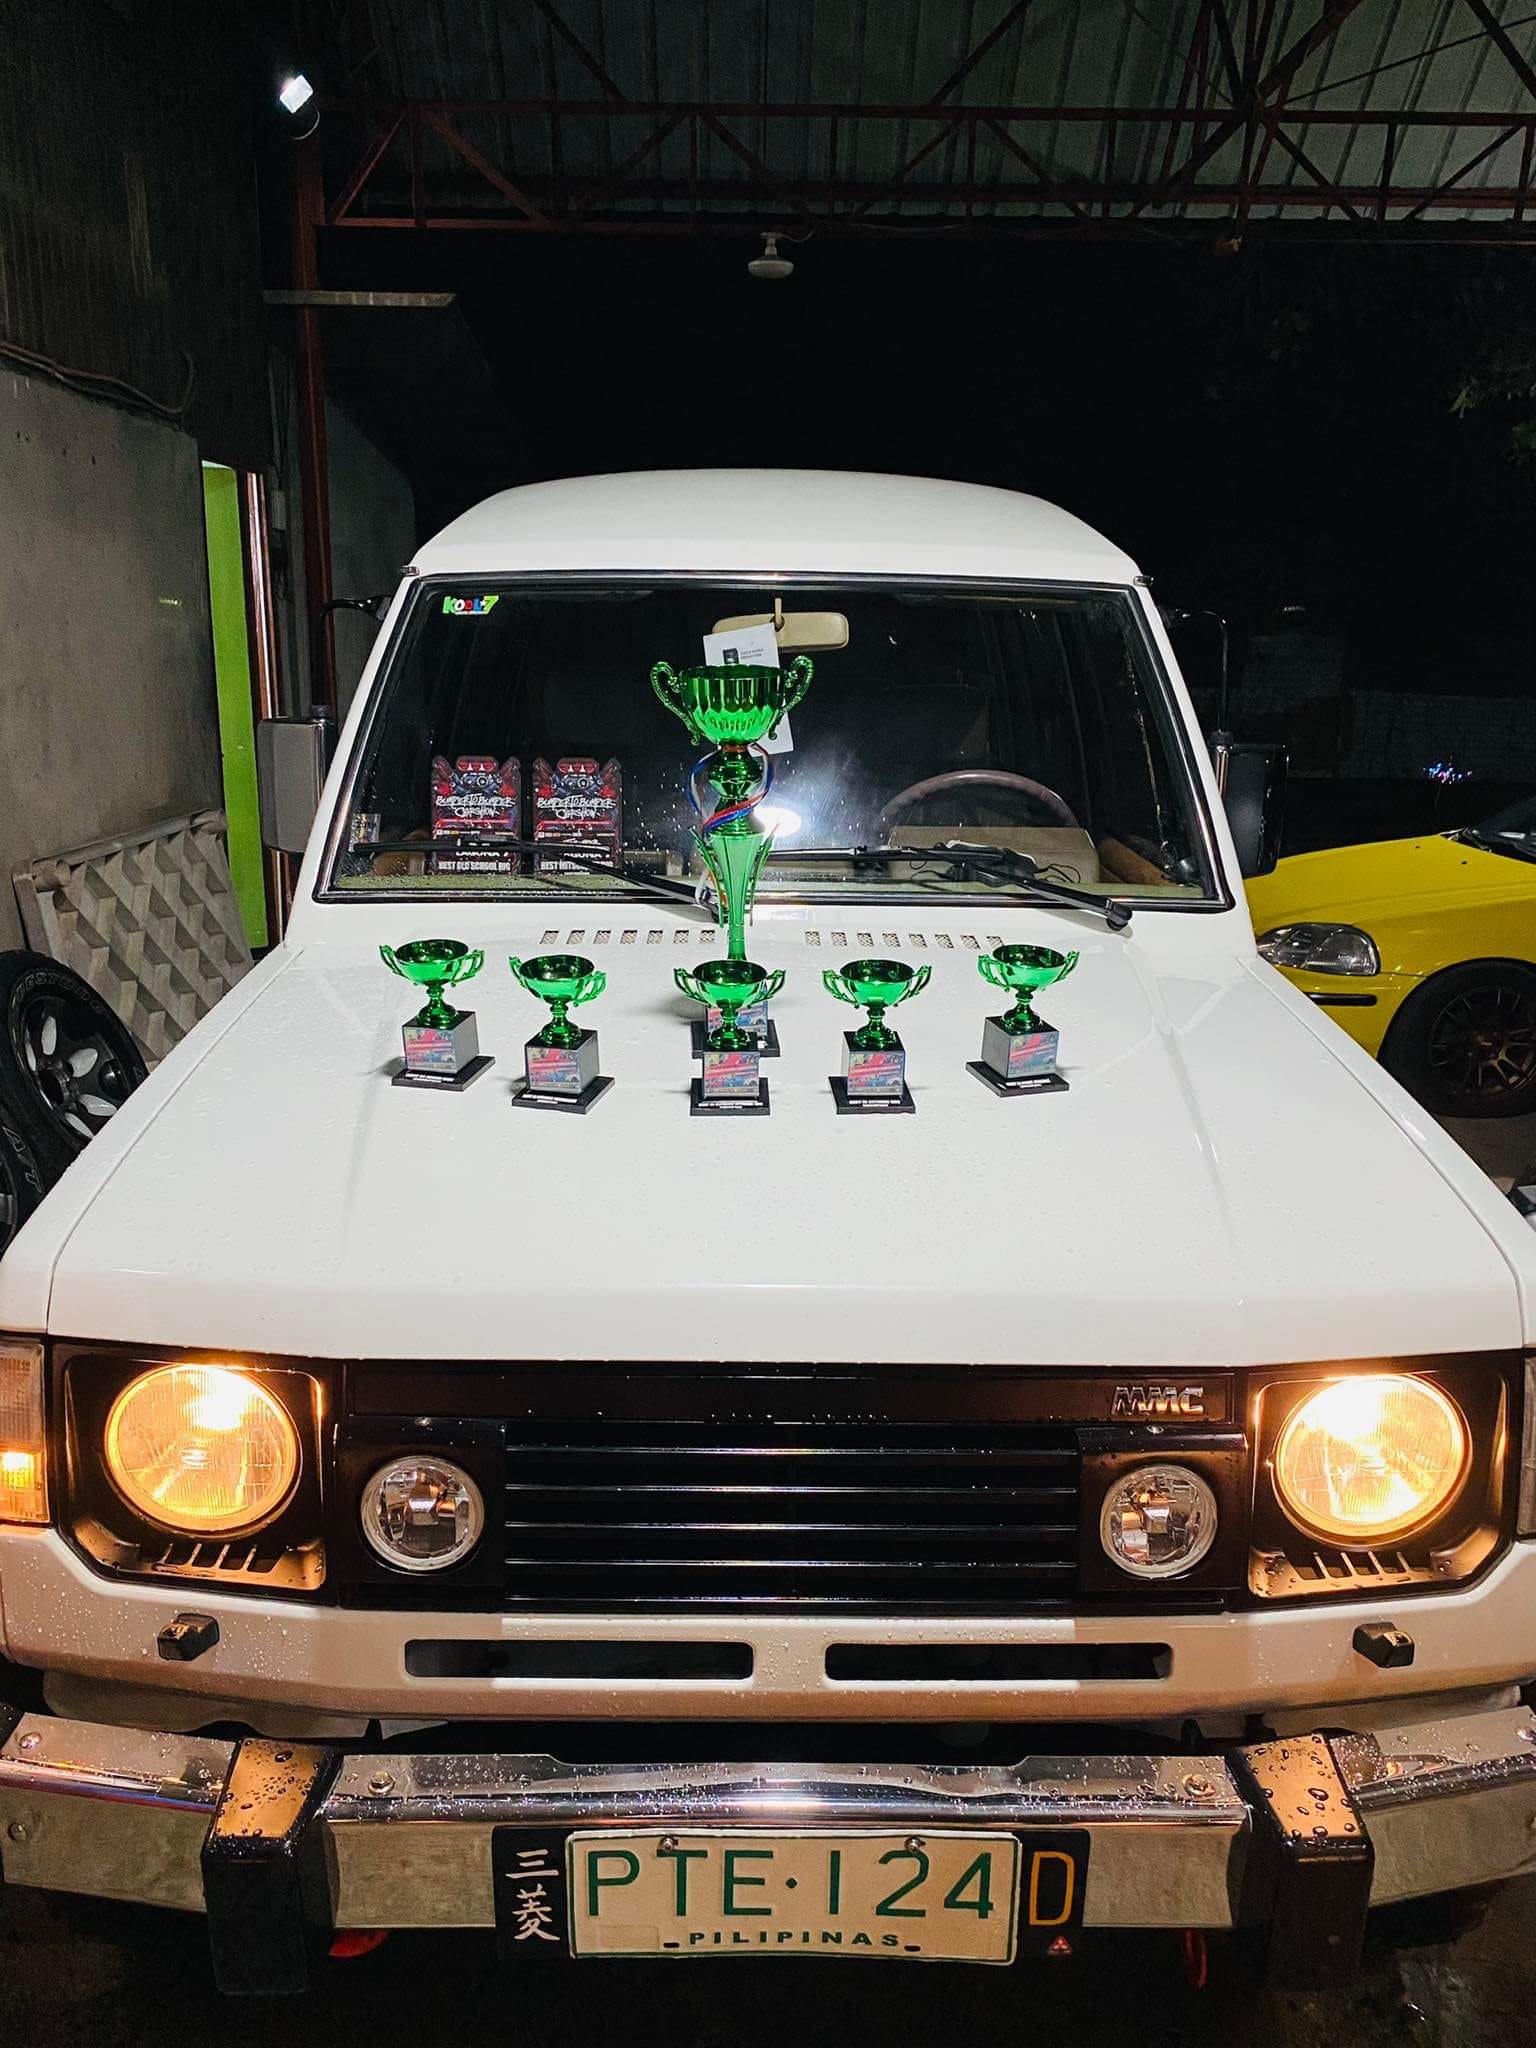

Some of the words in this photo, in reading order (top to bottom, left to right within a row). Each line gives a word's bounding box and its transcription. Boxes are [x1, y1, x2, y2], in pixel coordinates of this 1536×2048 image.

[1110, 1386, 1205, 1416] MMC
[504, 1848, 560, 1942] 三菱
[1028, 1850, 1075, 1926] D
[689, 1930, 899, 1947] PILIPINAS
